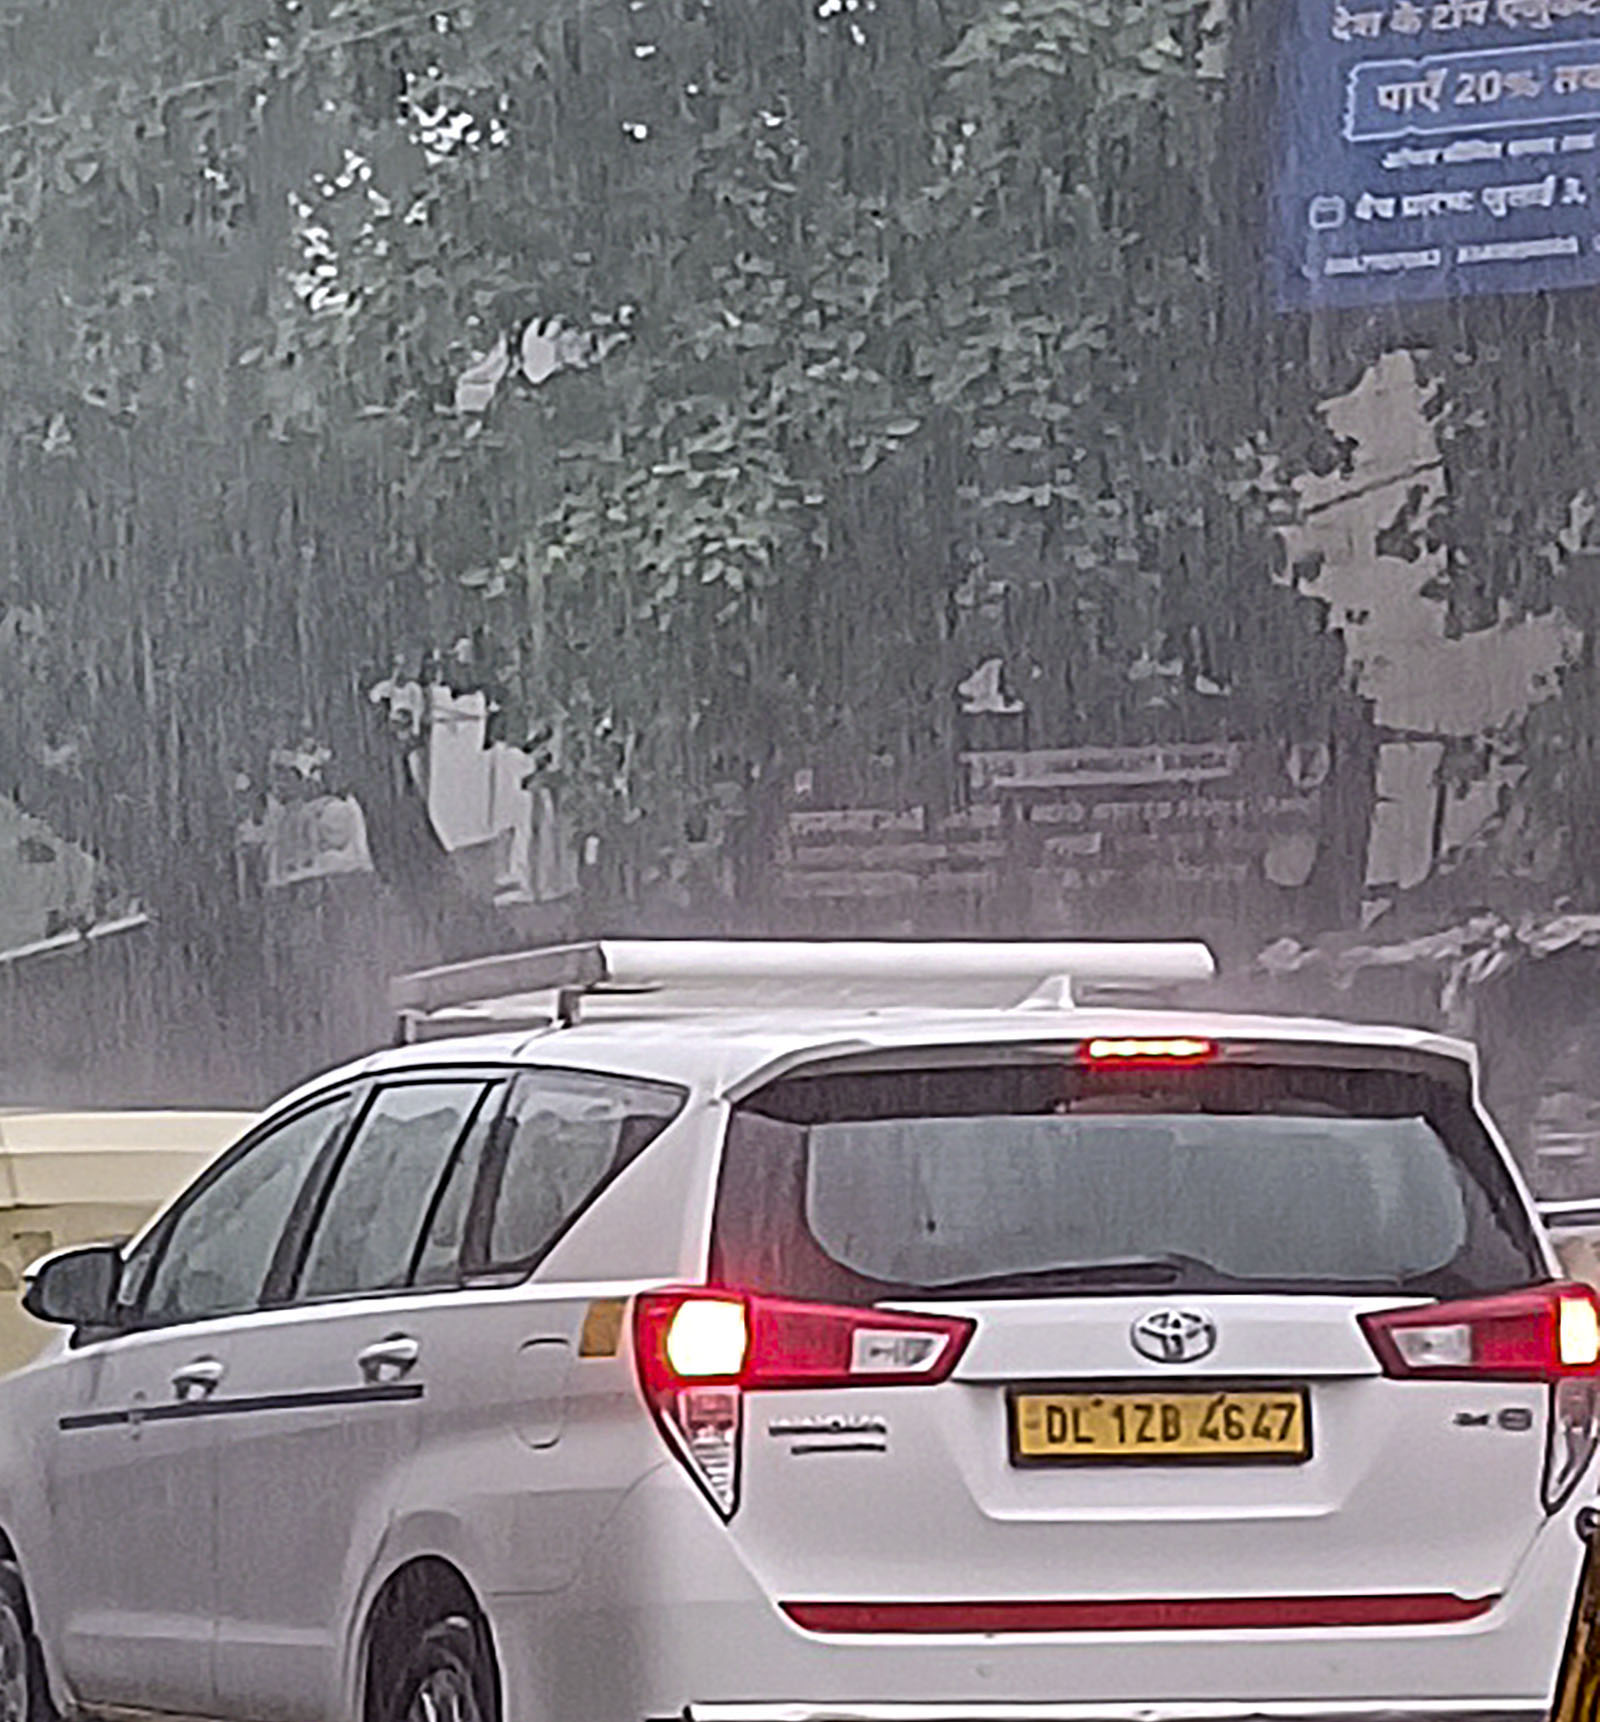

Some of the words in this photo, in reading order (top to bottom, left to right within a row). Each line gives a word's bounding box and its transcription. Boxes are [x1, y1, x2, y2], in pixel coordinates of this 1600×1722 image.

[1045, 1403, 1094, 1444] DL
[1111, 1402, 1181, 1444] 1ZB
[1198, 1398, 1297, 1442] 4647
